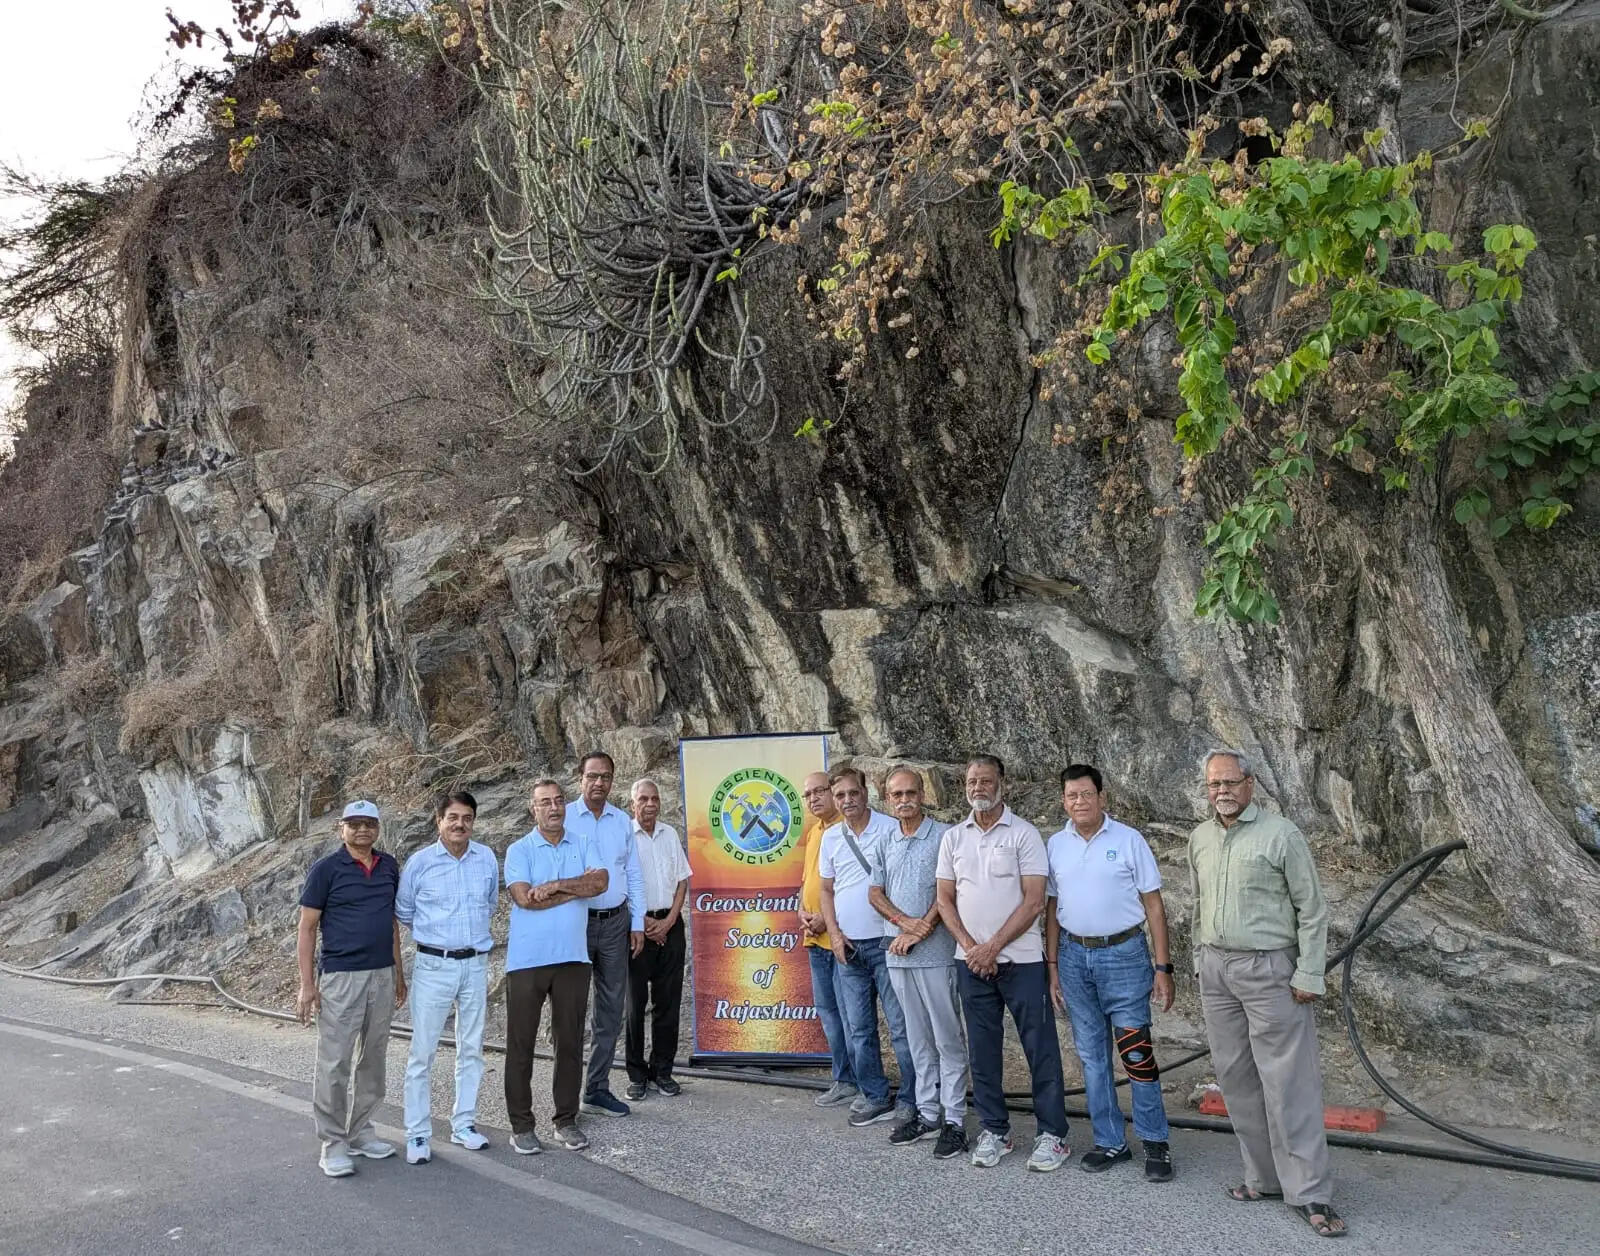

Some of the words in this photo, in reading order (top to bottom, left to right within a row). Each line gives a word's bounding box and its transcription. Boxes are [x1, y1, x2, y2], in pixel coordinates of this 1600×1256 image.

[711, 769, 802, 827] GEOSCIENTISTS
[723, 840, 792, 864] SOCIETY
[695, 892, 800, 912] Geoscienti
[724, 927, 799, 952] Society
[752, 963, 779, 989] of
[714, 999, 819, 1024] Rajasthan
